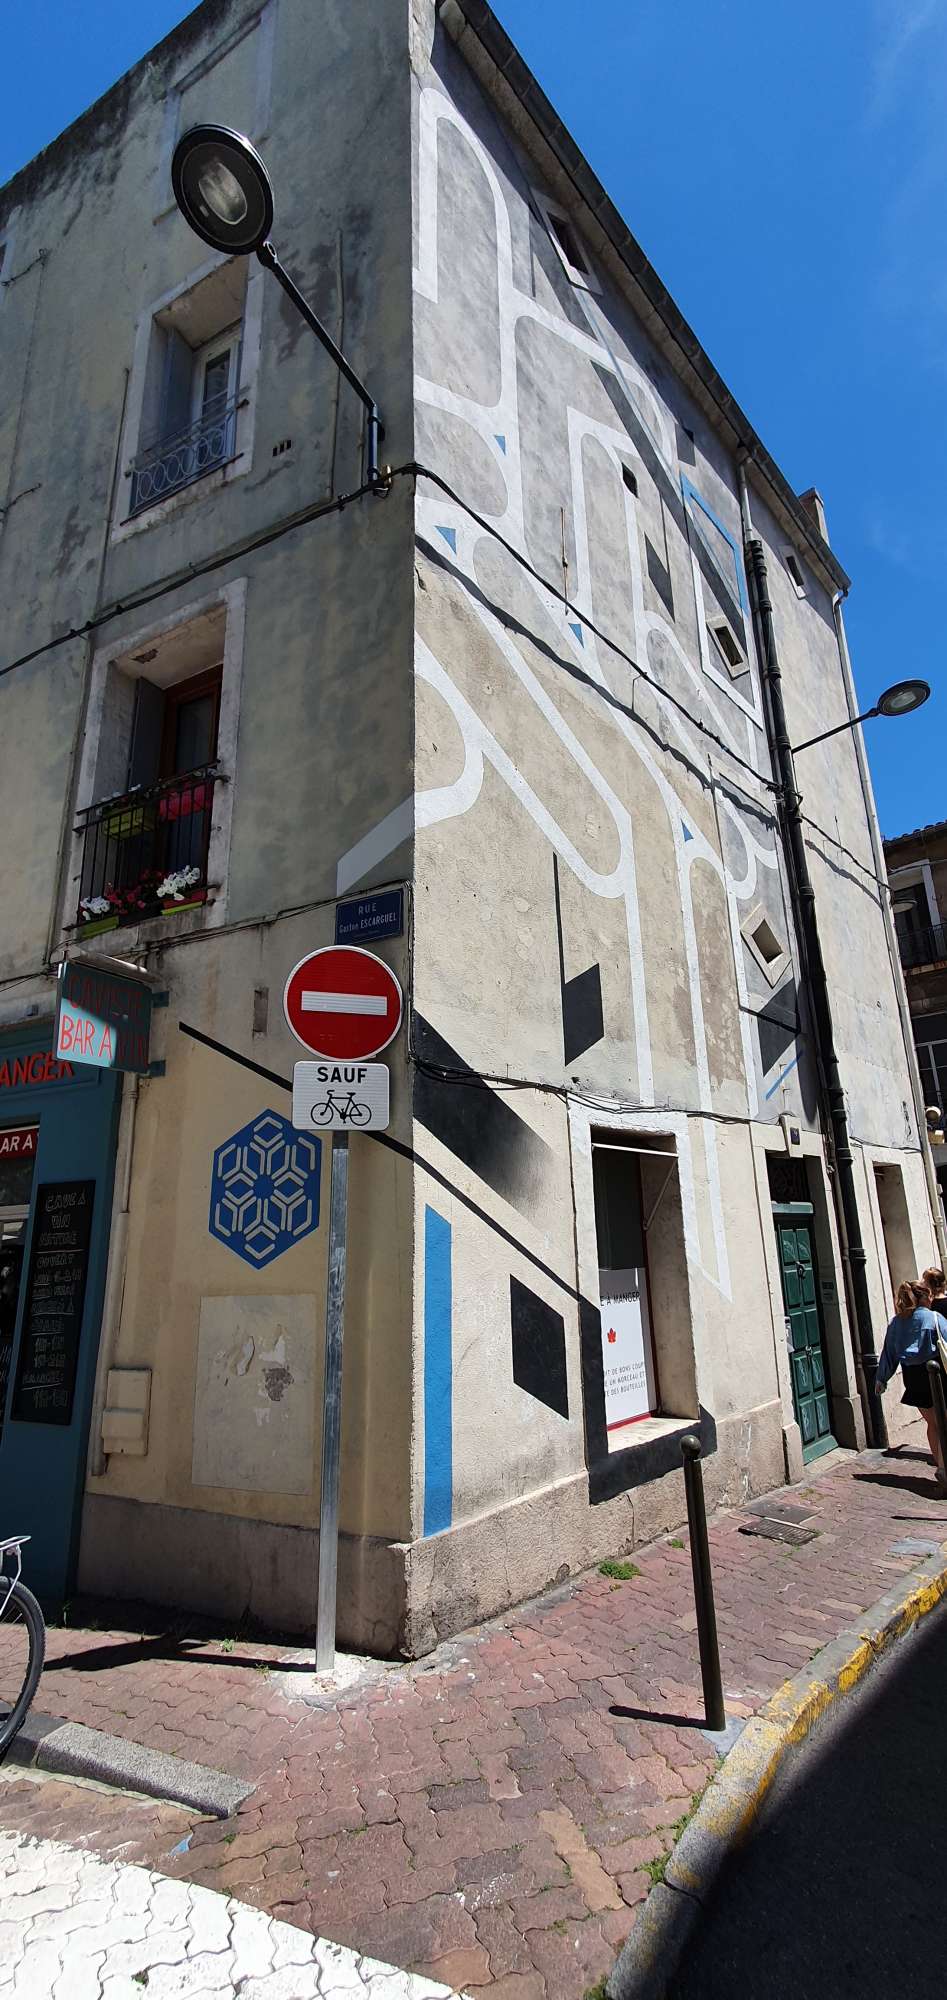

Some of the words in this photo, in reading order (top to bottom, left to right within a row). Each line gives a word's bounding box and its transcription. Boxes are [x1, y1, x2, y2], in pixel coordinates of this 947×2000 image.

[358, 903, 377, 915] RUE
[360, 912, 396, 929] ESCARGUEL
[68, 975, 145, 1027] CAVISTE
[60, 1014, 96, 1057] BAR
[316, 1066, 368, 1084] SAUF
[22, 1133, 33, 1151] A
[613, 1291, 640, 1304] MANGER
[611, 1367, 618, 1376] DE
[618, 1373, 639, 1384] MORCEAU
